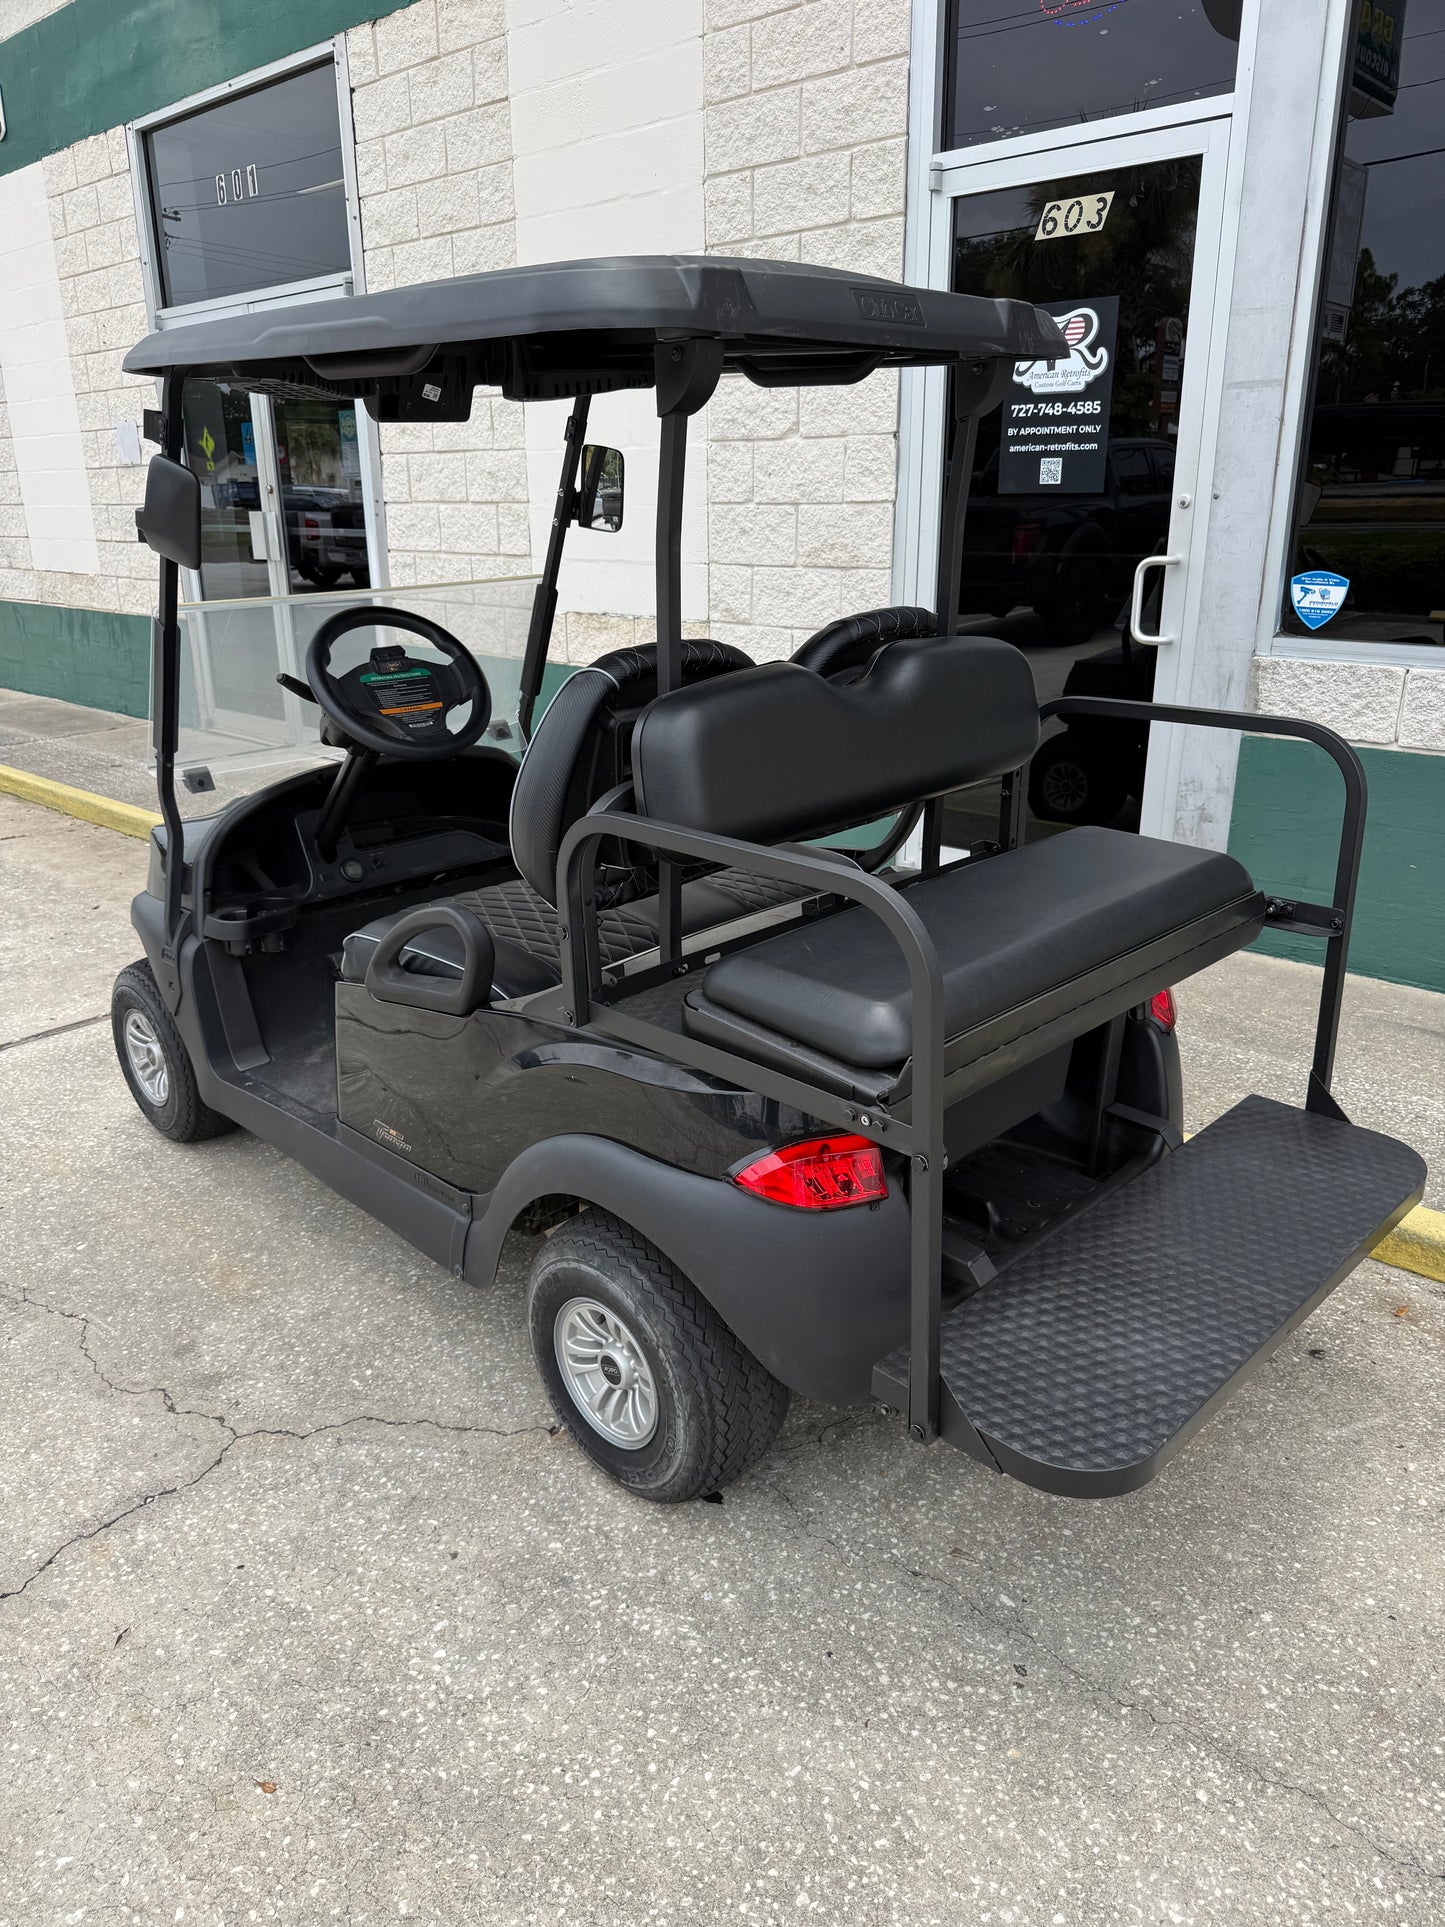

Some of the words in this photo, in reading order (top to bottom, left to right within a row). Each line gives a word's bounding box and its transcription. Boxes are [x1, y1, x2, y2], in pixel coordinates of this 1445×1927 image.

[217, 165, 257, 204] 601
[1042, 196, 1108, 236] 603
[1027, 371, 1059, 381] American
[1060, 367, 1091, 380] Retrofits
[1055, 379, 1067, 387] Golf
[1067, 379, 1081, 387] Carts
[1011, 401, 1101, 417] 727-748-4585
[1007, 426, 1019, 436] BY
[1019, 425, 1077, 435] APPOINTMENT
[1078, 424, 1102, 434] ONLY
[1009, 441, 1098, 453] american-retrofits.com
